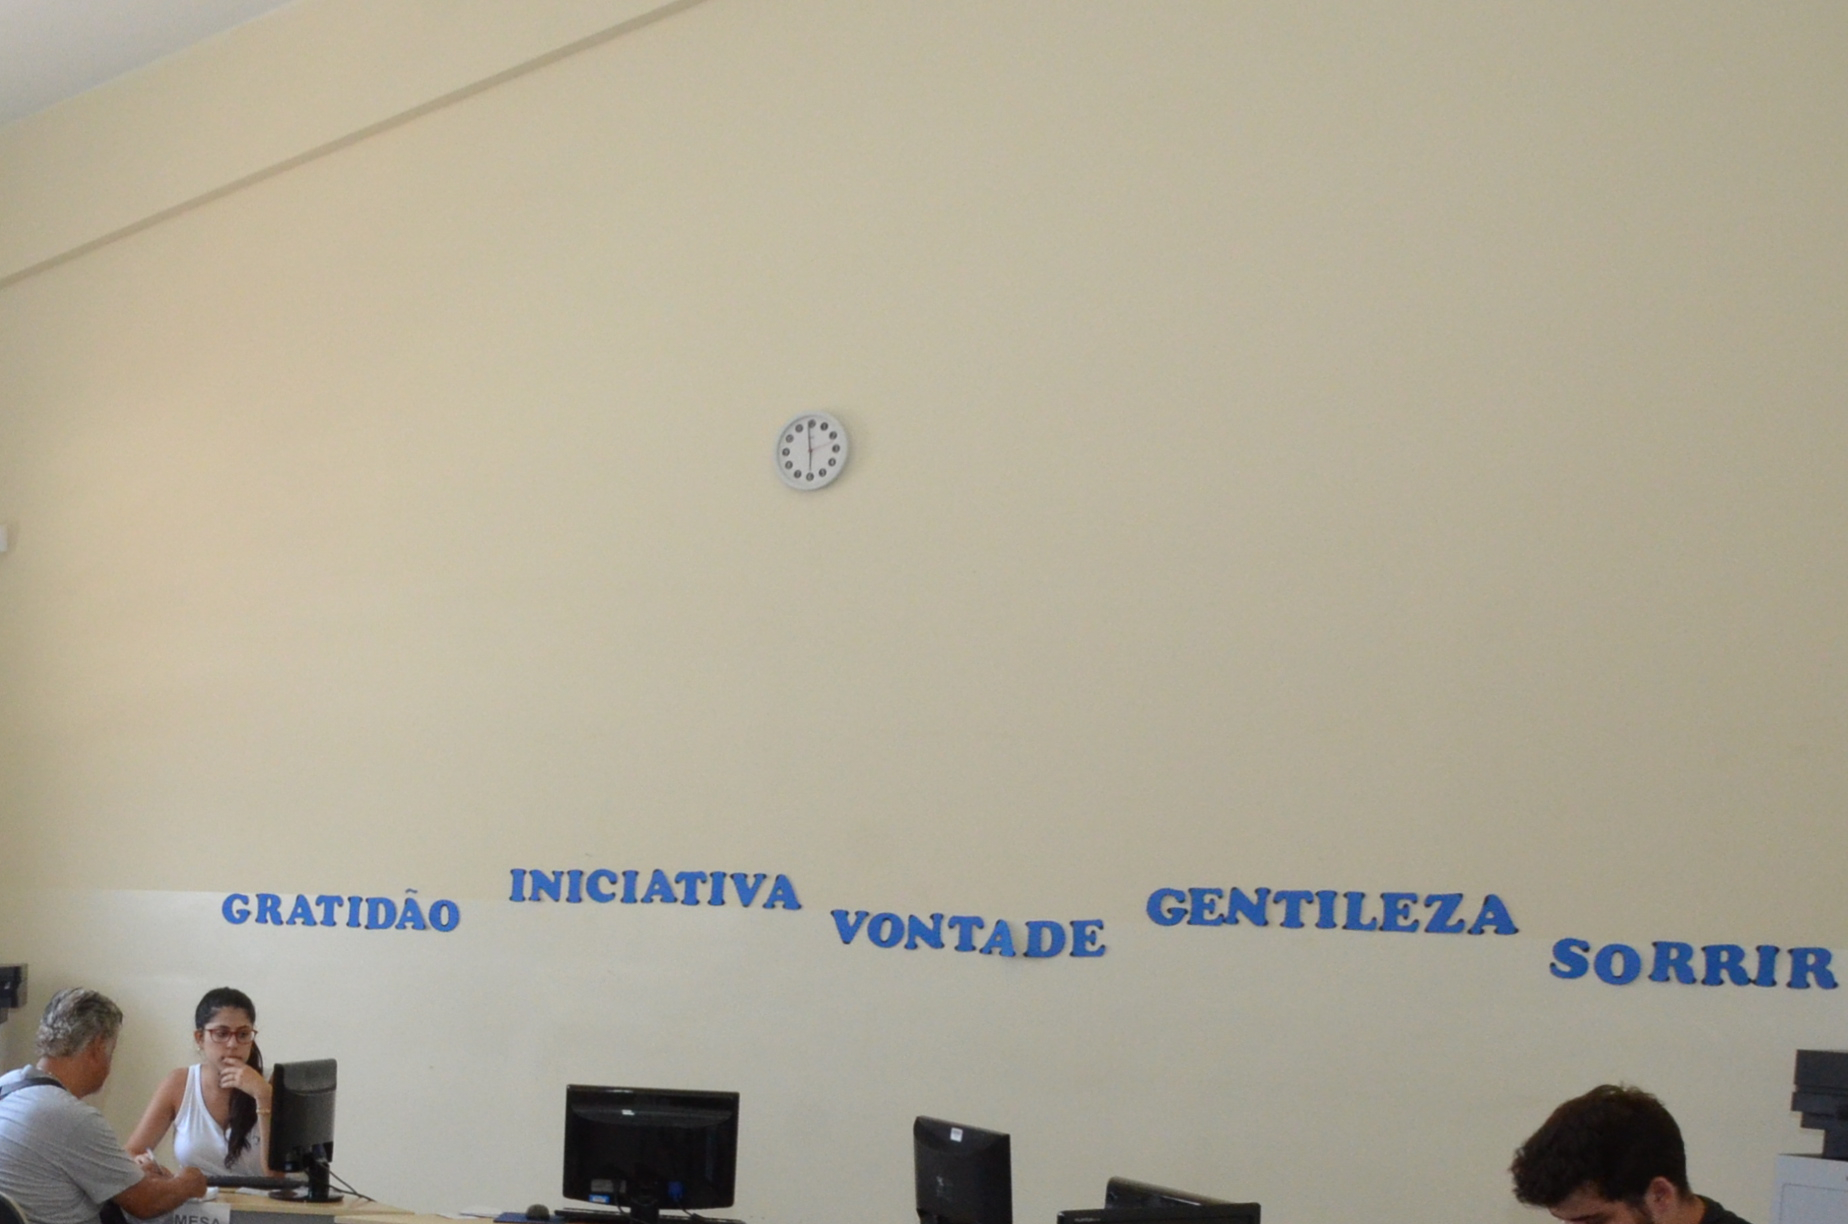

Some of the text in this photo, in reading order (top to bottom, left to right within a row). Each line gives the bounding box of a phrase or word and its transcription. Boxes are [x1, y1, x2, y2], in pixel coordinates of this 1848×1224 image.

[221, 888, 461, 933] GRATIDÃO
[509, 868, 802, 910] INICIATIVA
[1145, 886, 1520, 936] GENTILEZA
[830, 908, 1106, 958] VONTADE
[1549, 937, 1839, 990] SORRIR
